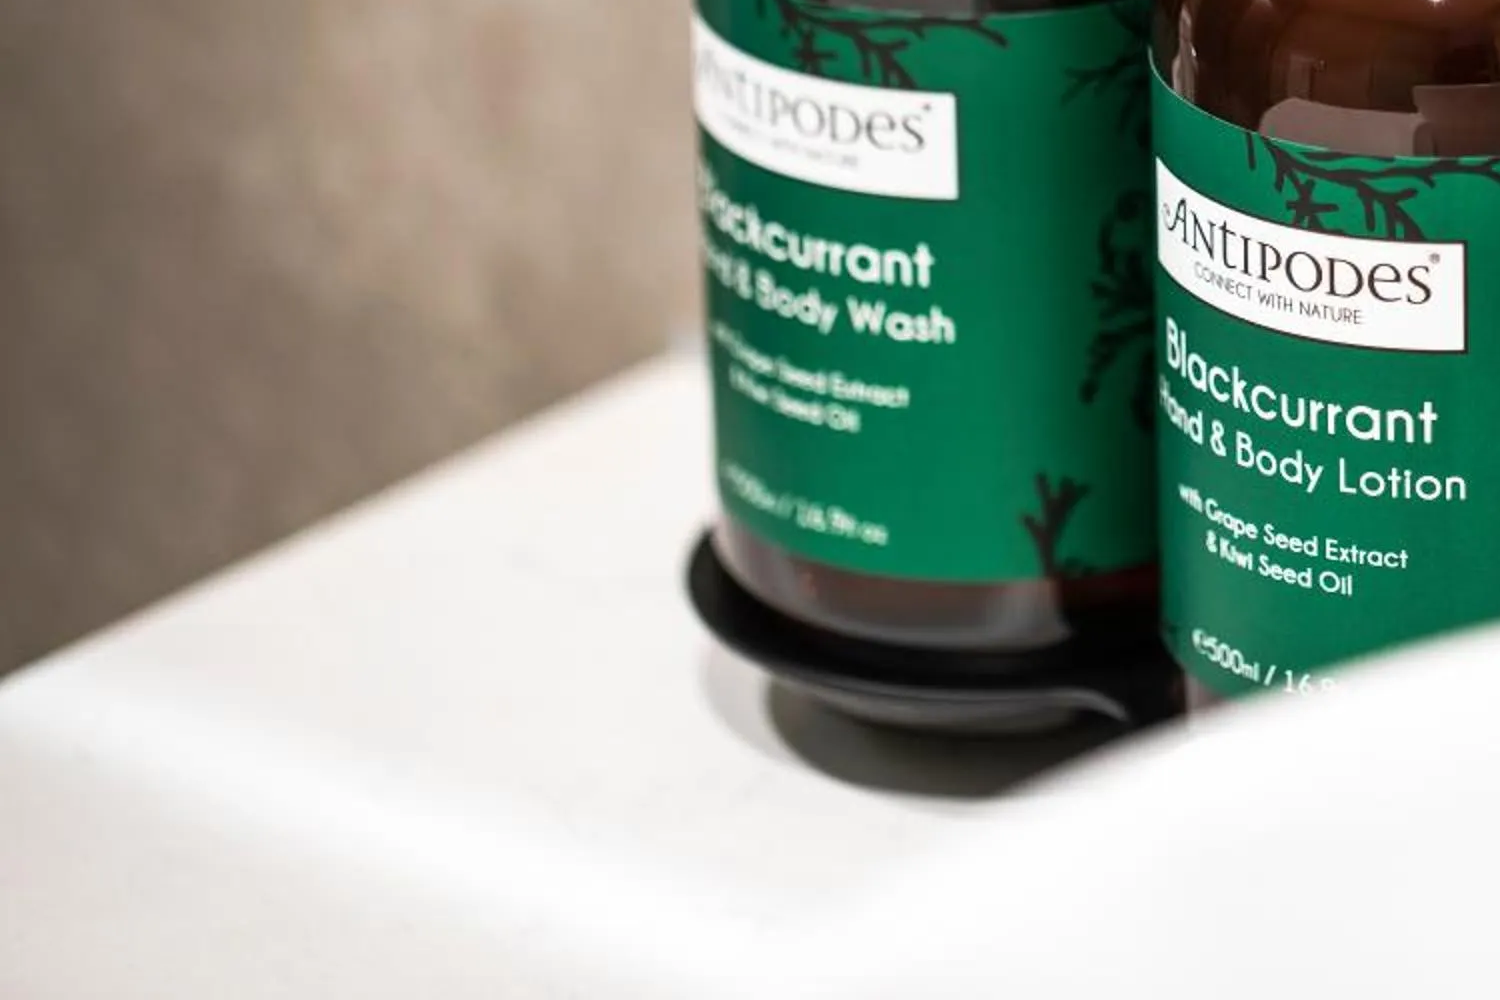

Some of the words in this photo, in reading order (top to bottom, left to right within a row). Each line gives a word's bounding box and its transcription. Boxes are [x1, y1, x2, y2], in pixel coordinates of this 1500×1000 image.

[697, 160, 935, 289] ackcurrant
[846, 294, 957, 345] Wash
[1194, 261, 1254, 302] CONNECT
[1257, 287, 1294, 313] WITH
[1299, 301, 1364, 326] NATURE
[1166, 315, 1439, 444] Blackcurrant
[1209, 419, 1227, 457] &
[1235, 430, 1324, 493] Body
[1339, 457, 1467, 501] Lotion
[1204, 498, 1258, 540] Grape
[1263, 523, 1319, 557] Seed
[1325, 538, 1409, 569] Extract
[1205, 530, 1218, 553] &
[1219, 540, 1253, 571] Kiwi
[1258, 553, 1313, 589] Seed
[1319, 571, 1353, 597] Oil
